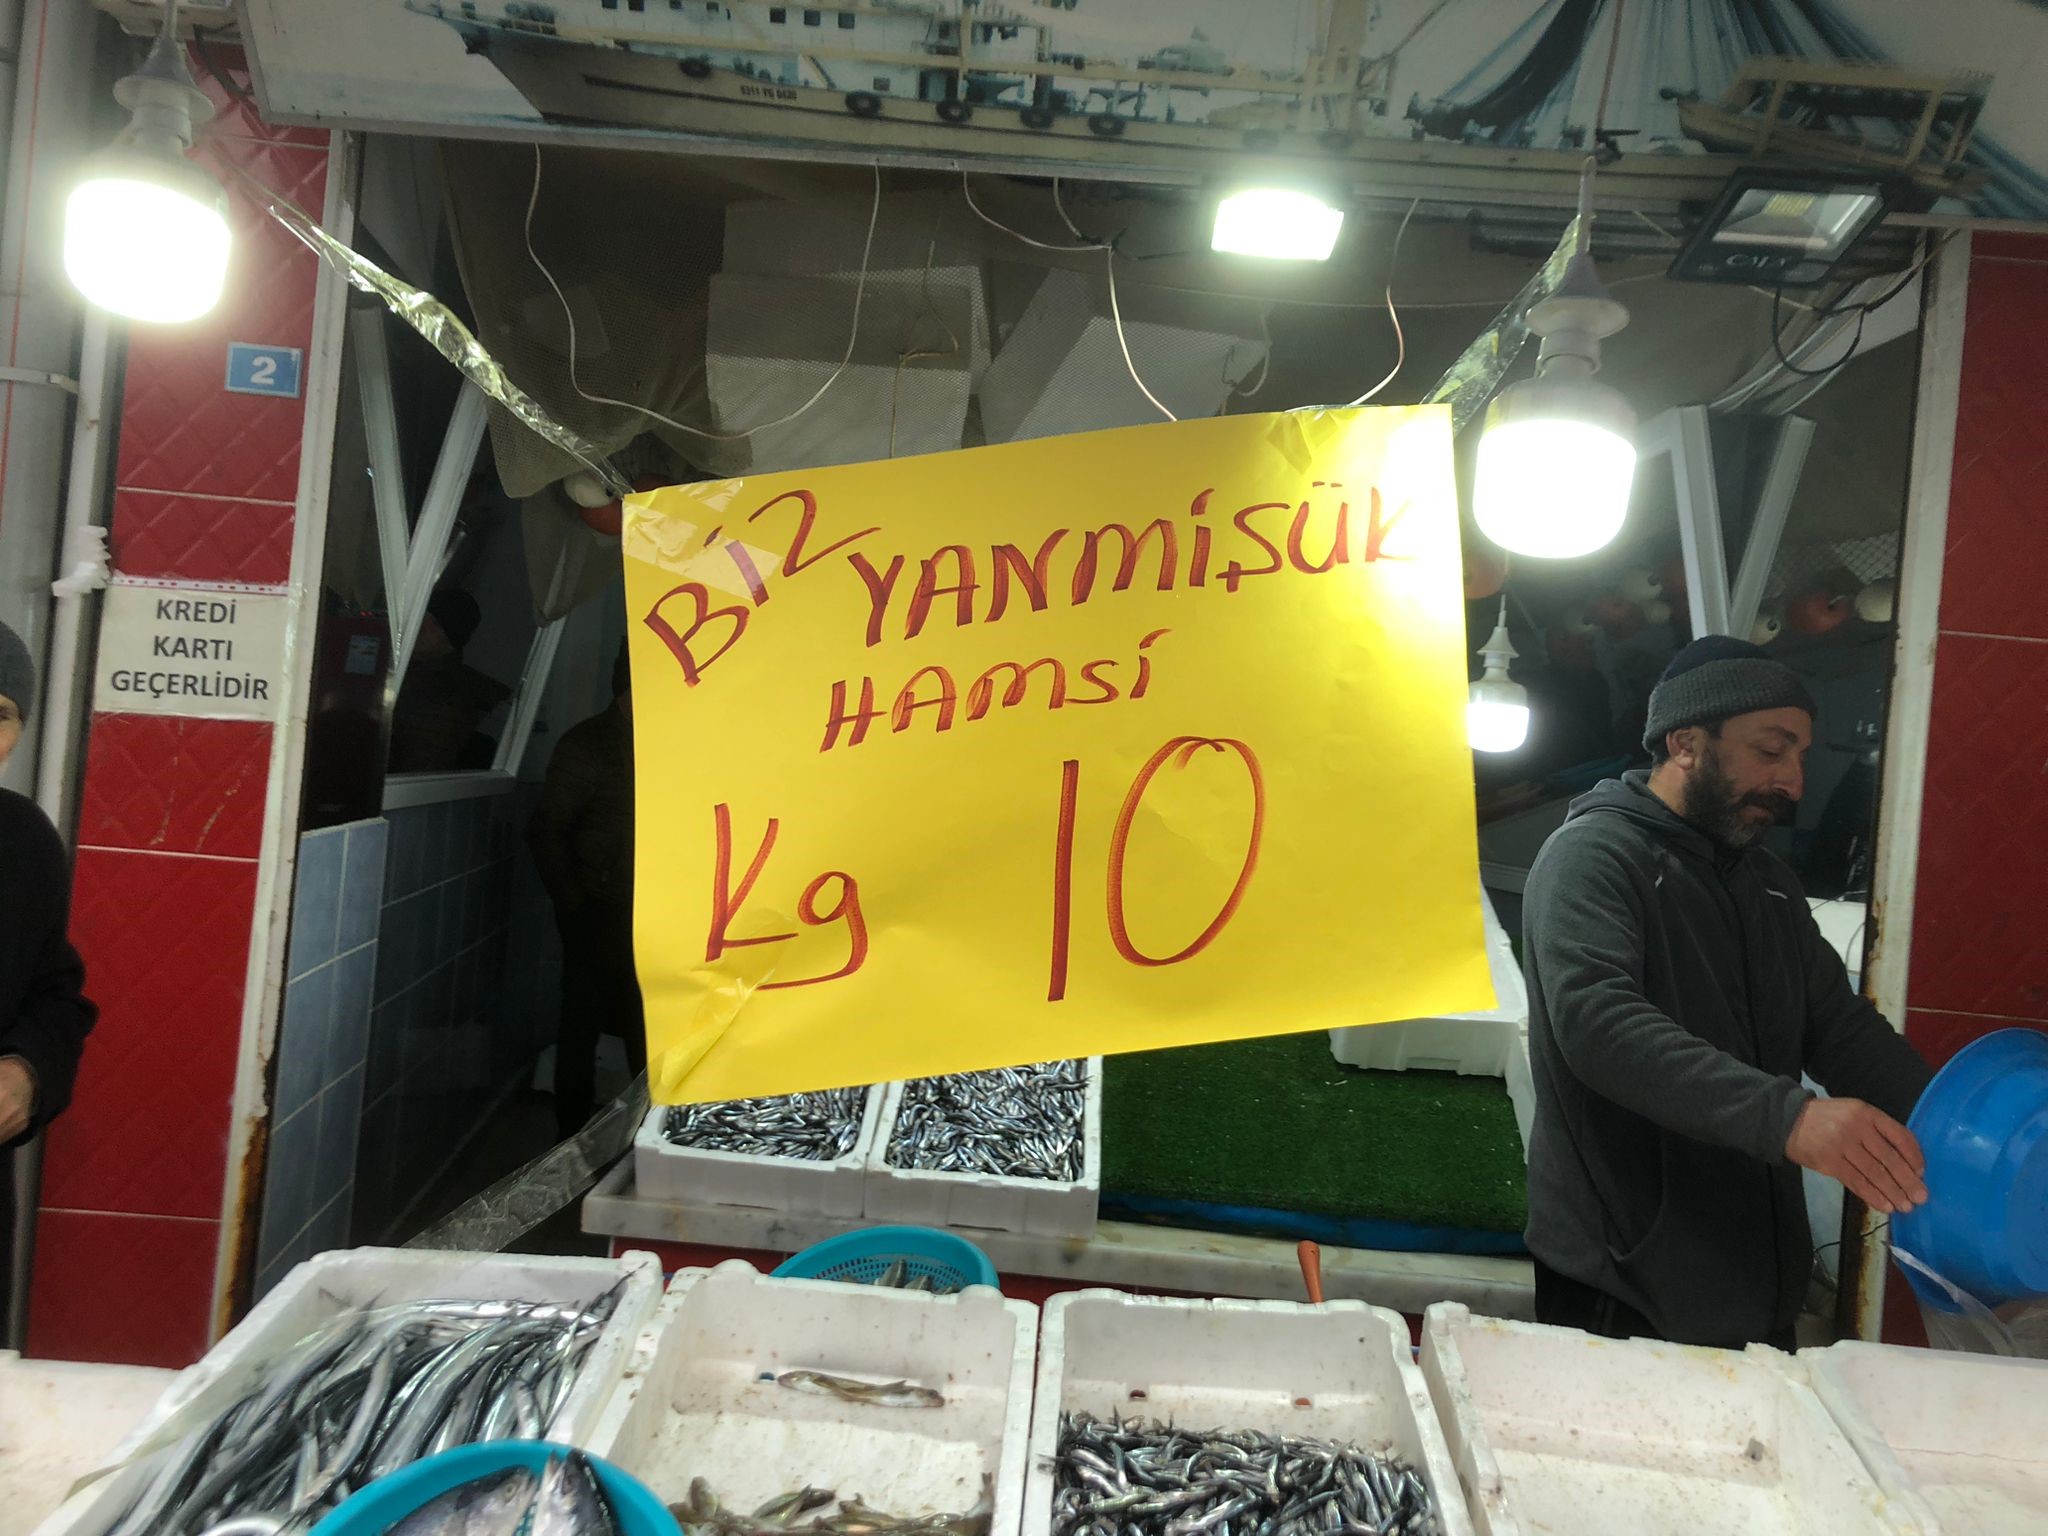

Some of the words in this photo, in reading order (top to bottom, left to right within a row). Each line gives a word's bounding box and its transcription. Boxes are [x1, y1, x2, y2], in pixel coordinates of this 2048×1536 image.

[250, 356, 277, 384] 2
[156, 599, 237, 624] KREDİ
[153, 635, 233, 661] KARTI
[111, 670, 269, 701] GEÇERLİDİR
[705, 802, 868, 990] Kg
[1047, 735, 1266, 1001] 10
